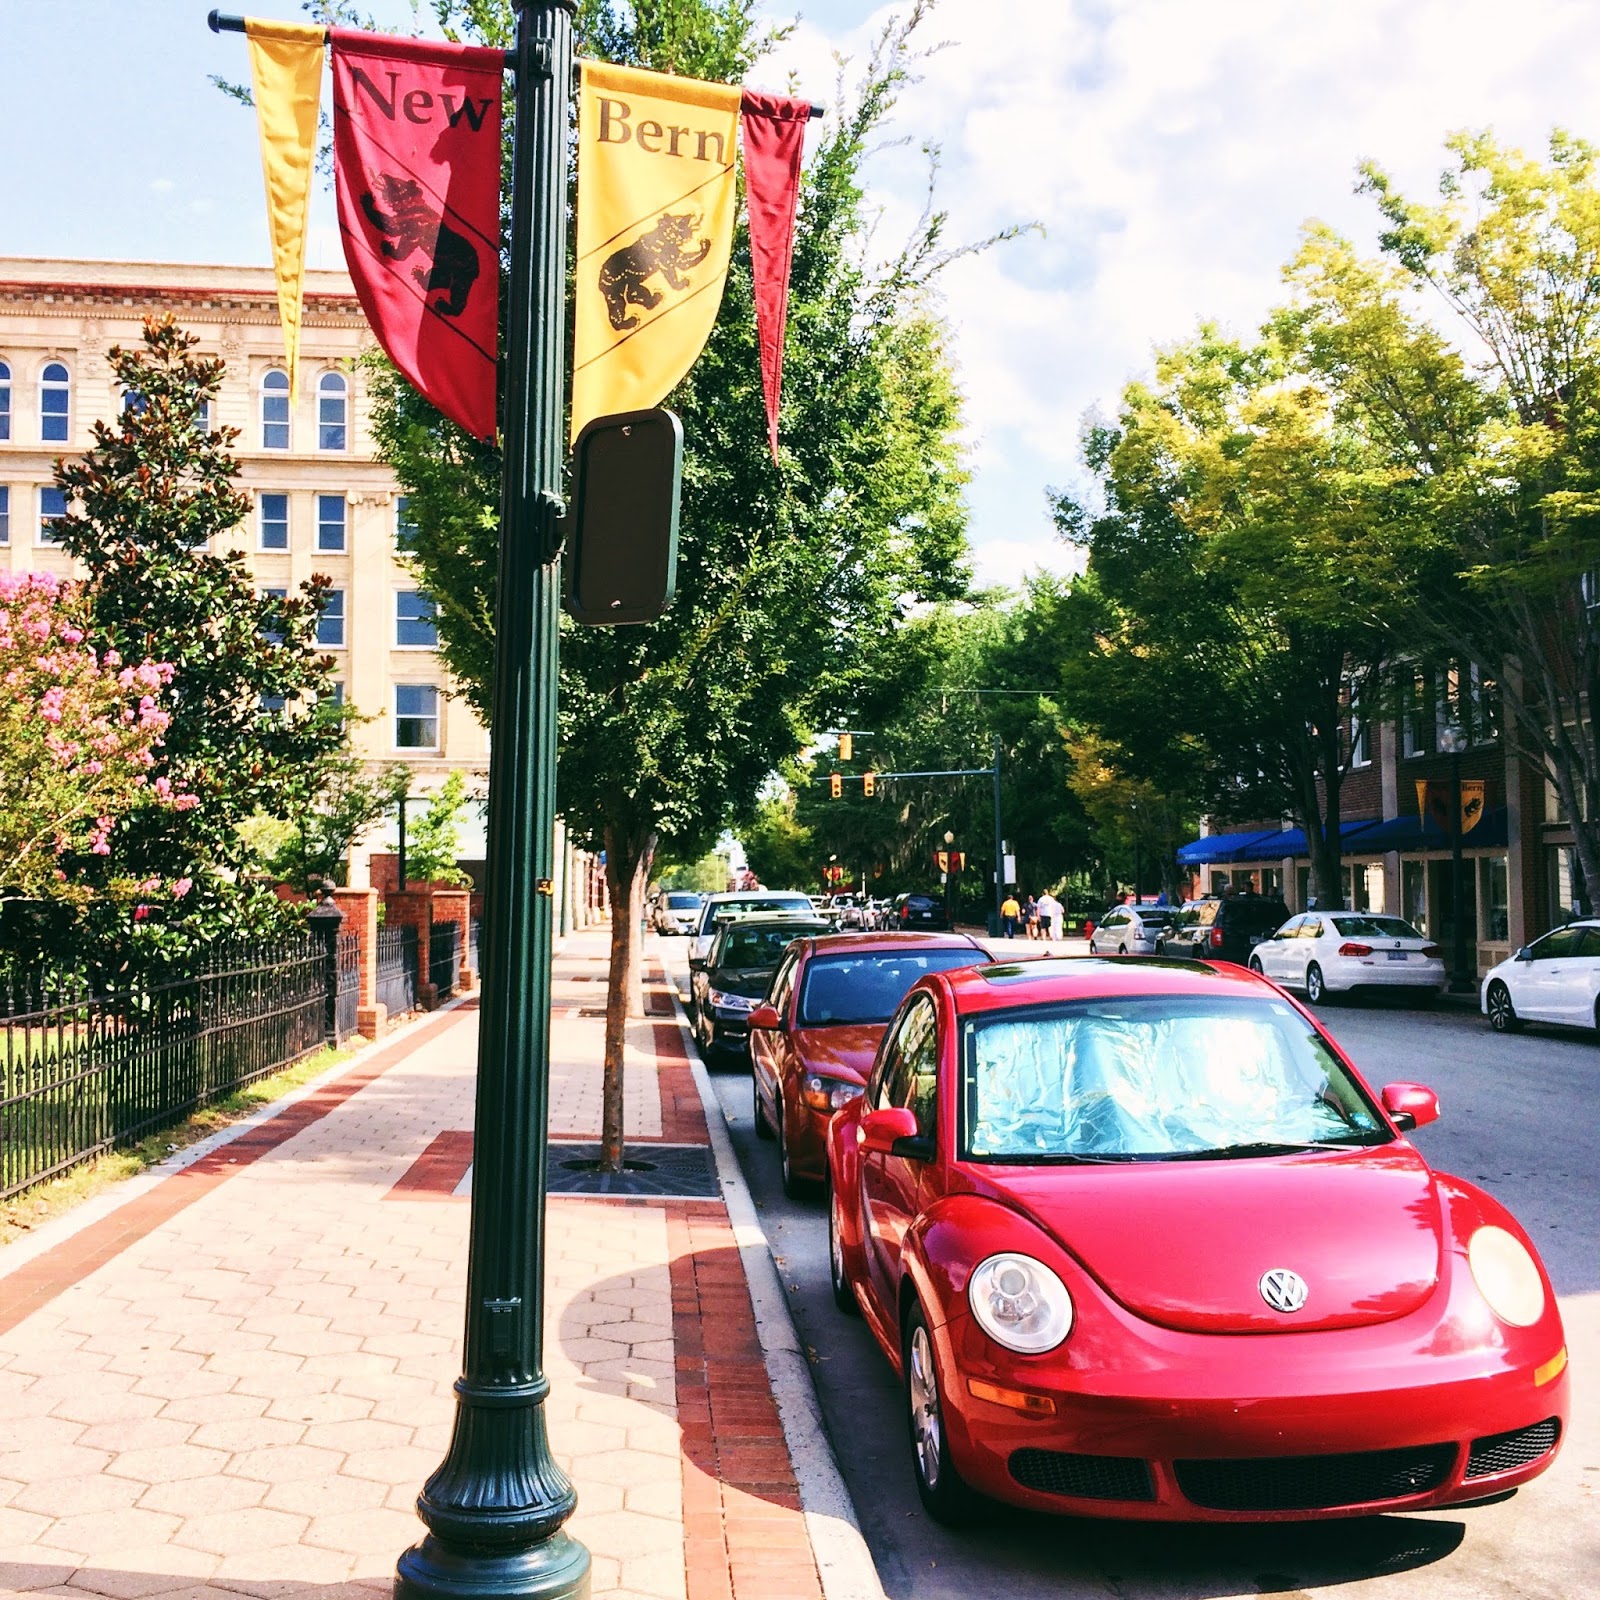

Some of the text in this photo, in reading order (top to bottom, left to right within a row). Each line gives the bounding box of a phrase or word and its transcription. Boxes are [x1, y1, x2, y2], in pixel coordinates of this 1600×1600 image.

[352, 67, 493, 132] New
[596, 97, 727, 165] Bern
[1462, 782, 1483, 791] Bern
